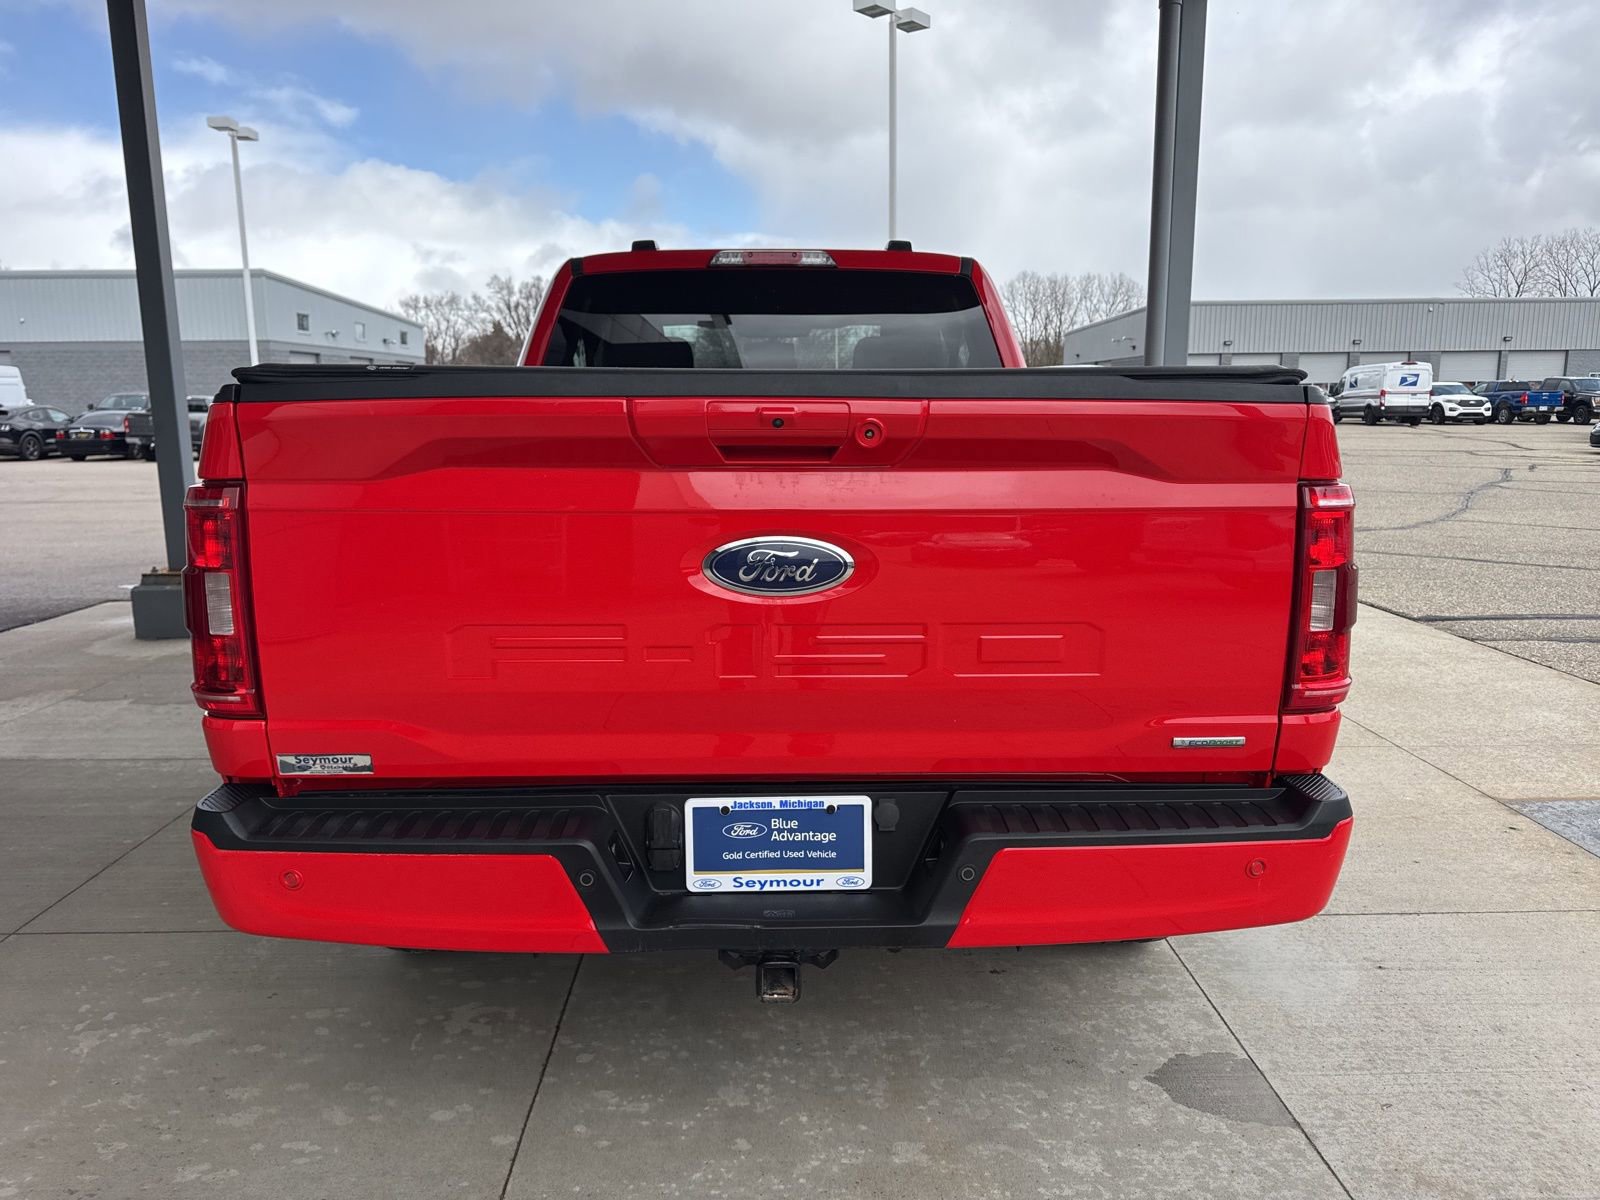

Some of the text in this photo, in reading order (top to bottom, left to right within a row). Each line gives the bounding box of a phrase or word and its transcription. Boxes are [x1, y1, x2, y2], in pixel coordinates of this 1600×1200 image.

[738, 549, 818, 582] Ford
[294, 756, 354, 766] Seymour
[780, 800, 825, 810] Michigan
[771, 818, 798, 829] Blue
[731, 824, 759, 837] Ford
[771, 831, 837, 843] Advantage
[722, 850, 837, 860] Gold Certified Used Vehicle
[733, 877, 825, 890] Seymour
